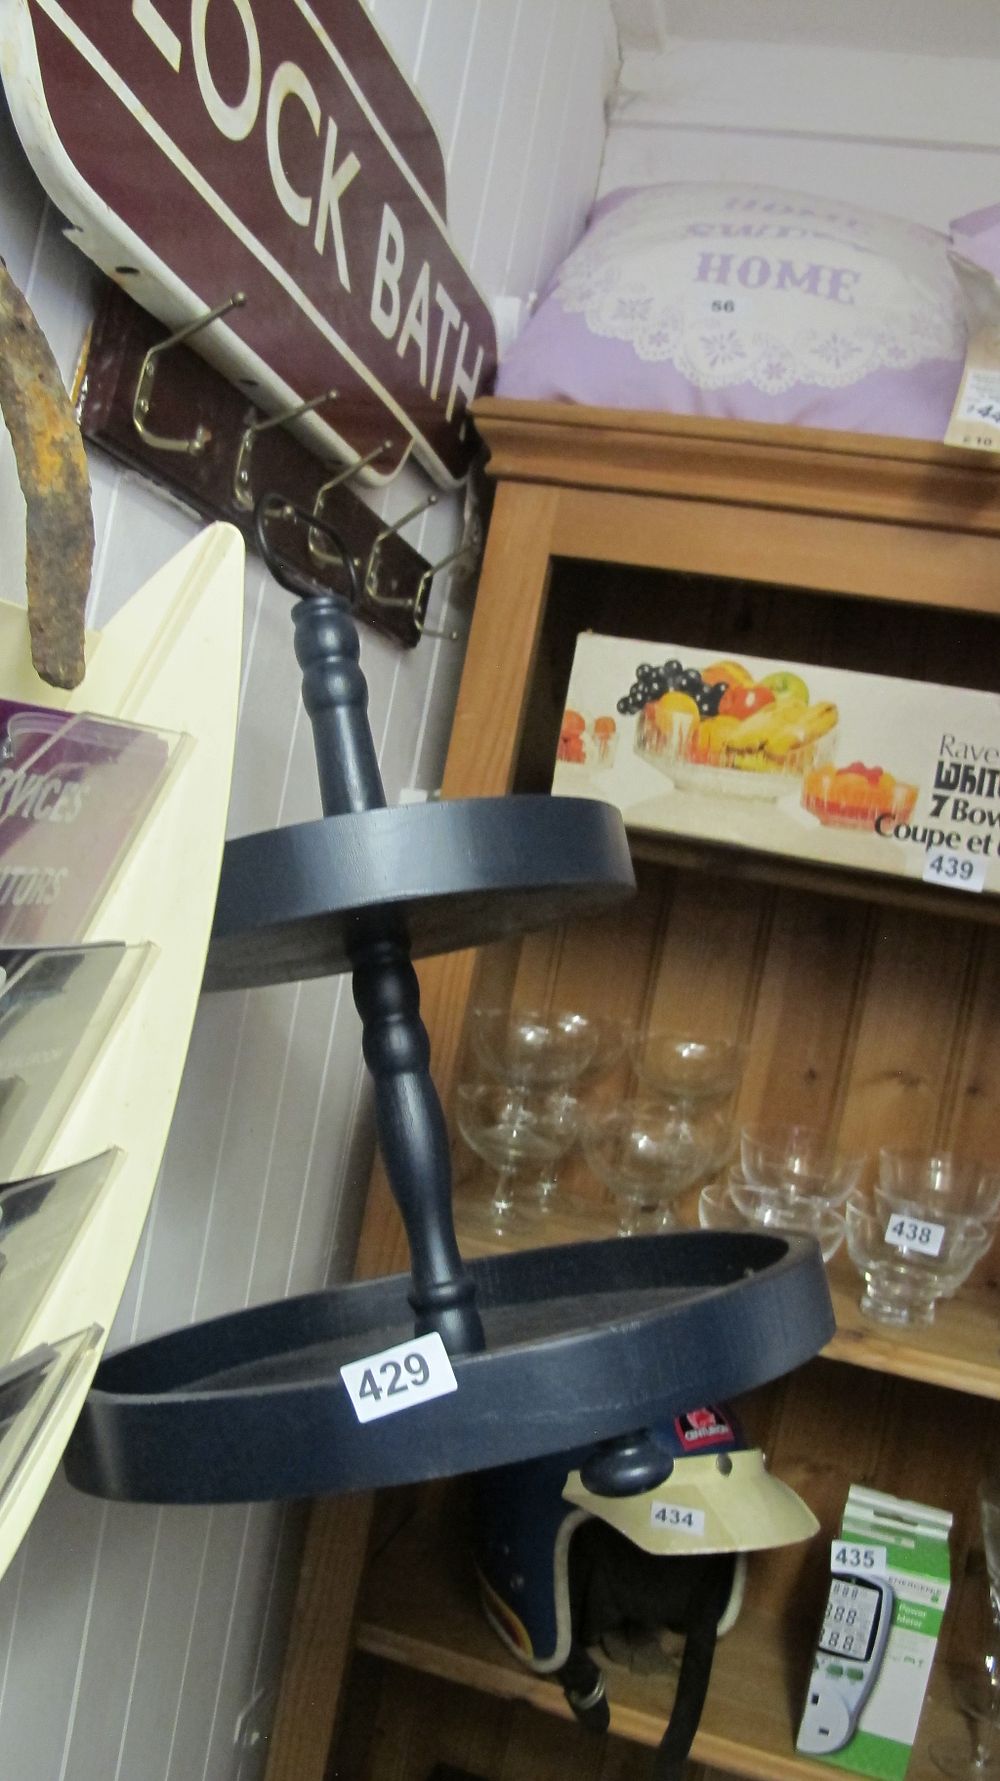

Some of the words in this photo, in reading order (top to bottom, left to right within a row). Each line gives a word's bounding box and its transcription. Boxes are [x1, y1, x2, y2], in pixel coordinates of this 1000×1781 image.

[692, 251, 862, 305] HOME
[371, 203, 484, 436] BATH
[934, 760, 1000, 798] WHIT
[930, 794, 951, 818] 7
[874, 813, 961, 852] Coupe
[966, 833, 992, 856] et
[929, 856, 974, 881] 439
[892, 1221, 931, 1244] 438
[358, 1352, 430, 1402] 429
[655, 1508, 693, 1527] 434
[835, 1547, 875, 1569] 435
